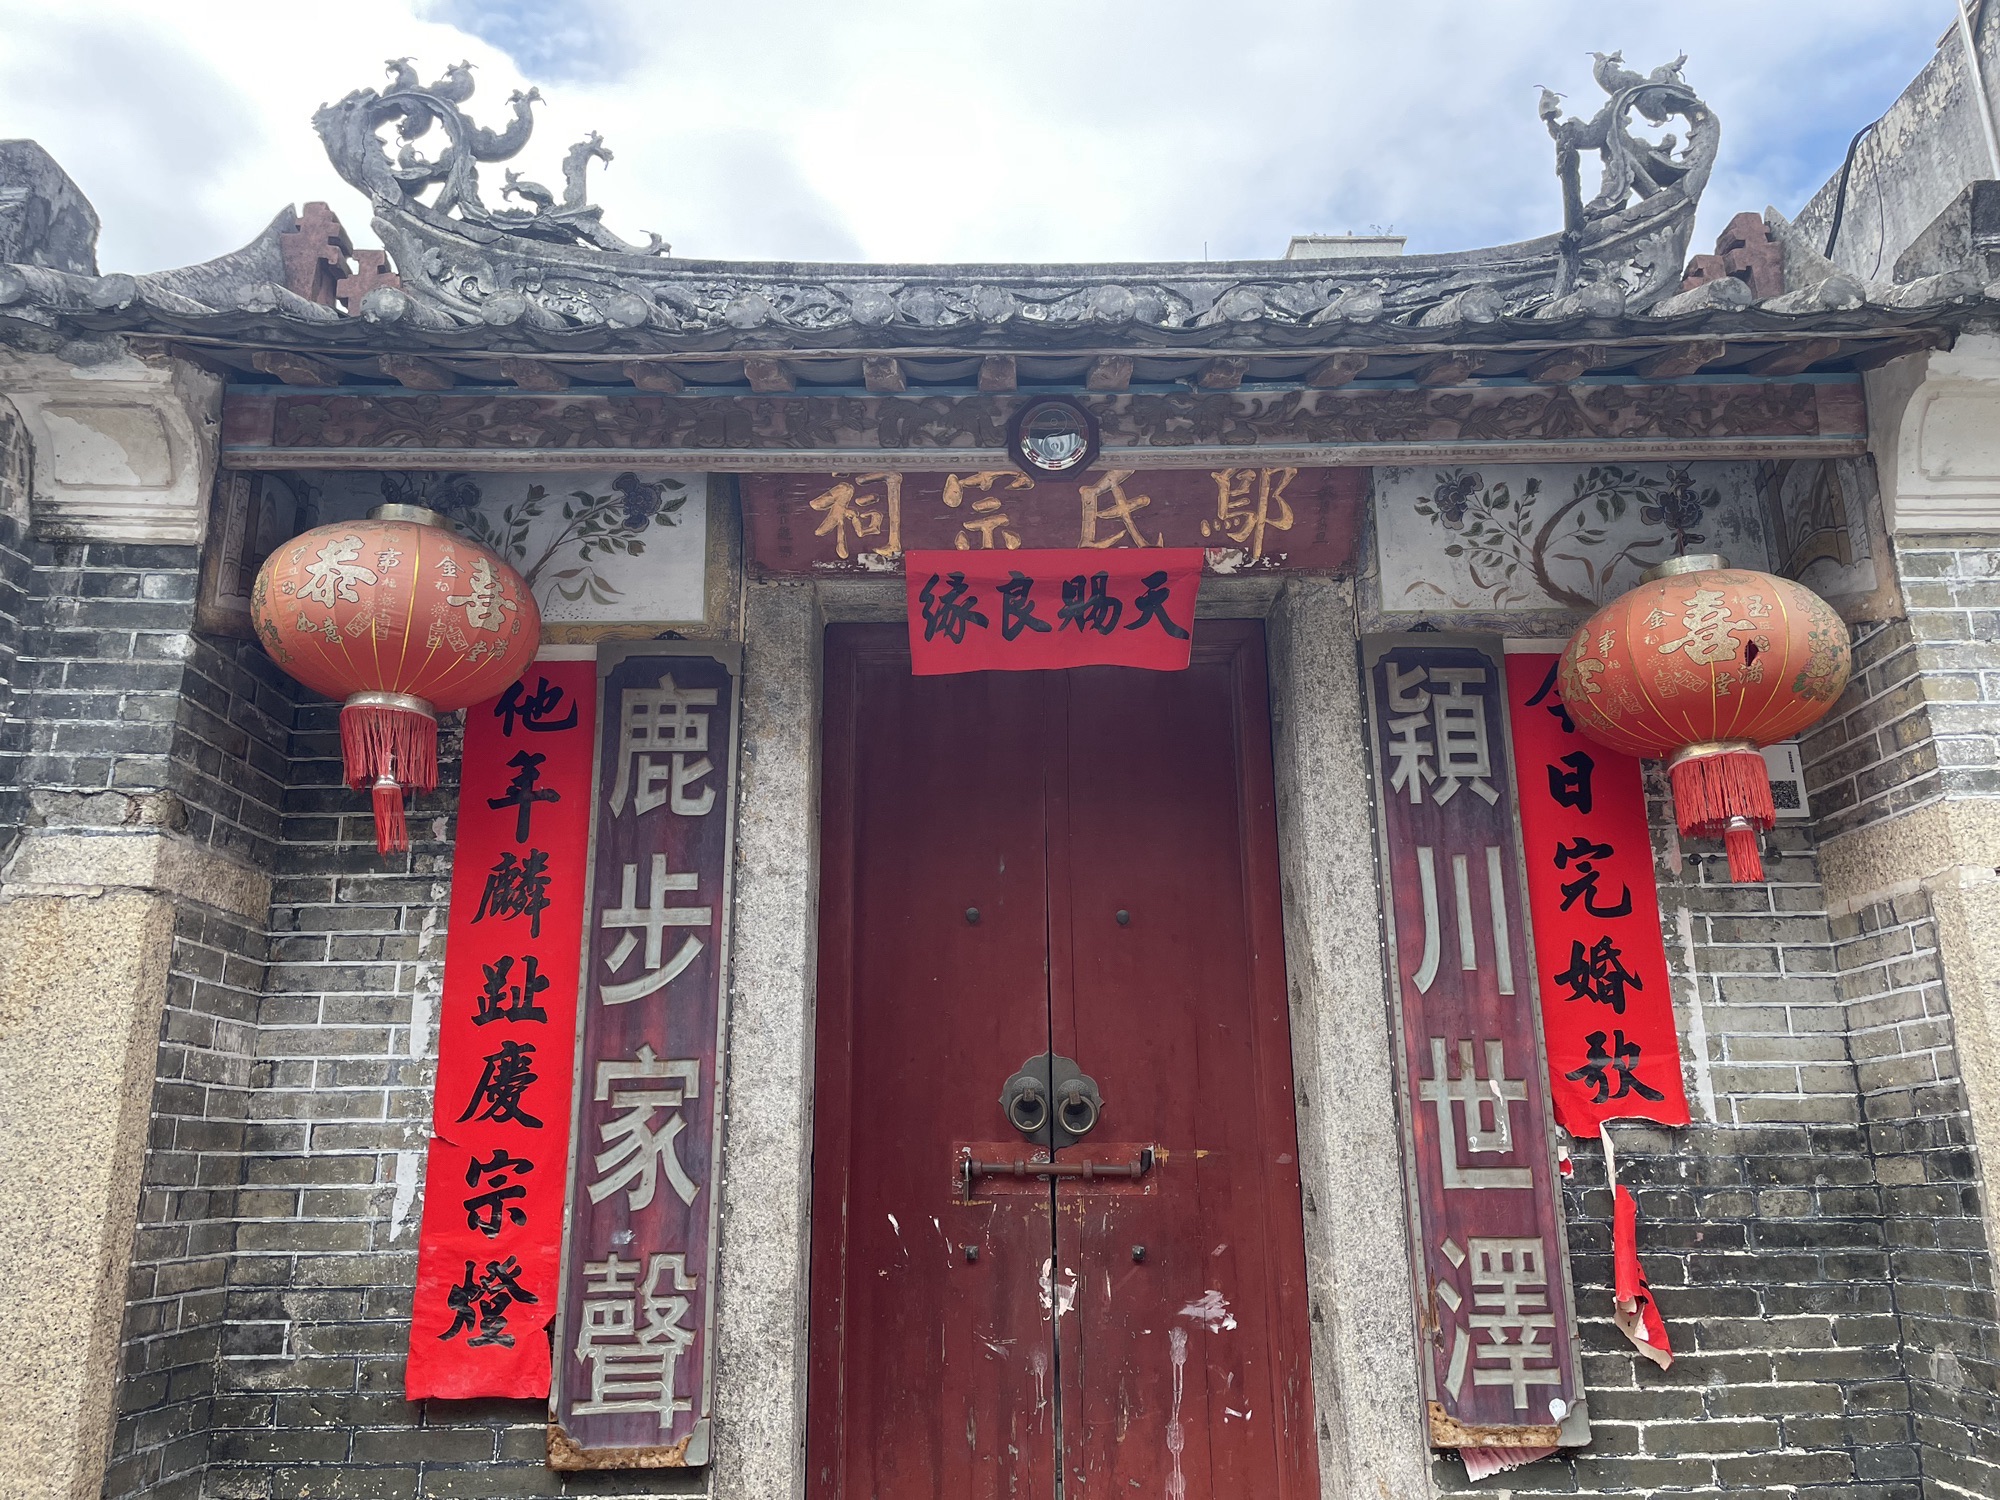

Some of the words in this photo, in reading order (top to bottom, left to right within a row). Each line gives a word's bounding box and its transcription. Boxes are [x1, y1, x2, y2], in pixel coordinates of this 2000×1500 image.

[1658, 589, 1757, 666] 喜
[571, 671, 719, 1429] 鹿步家聲
